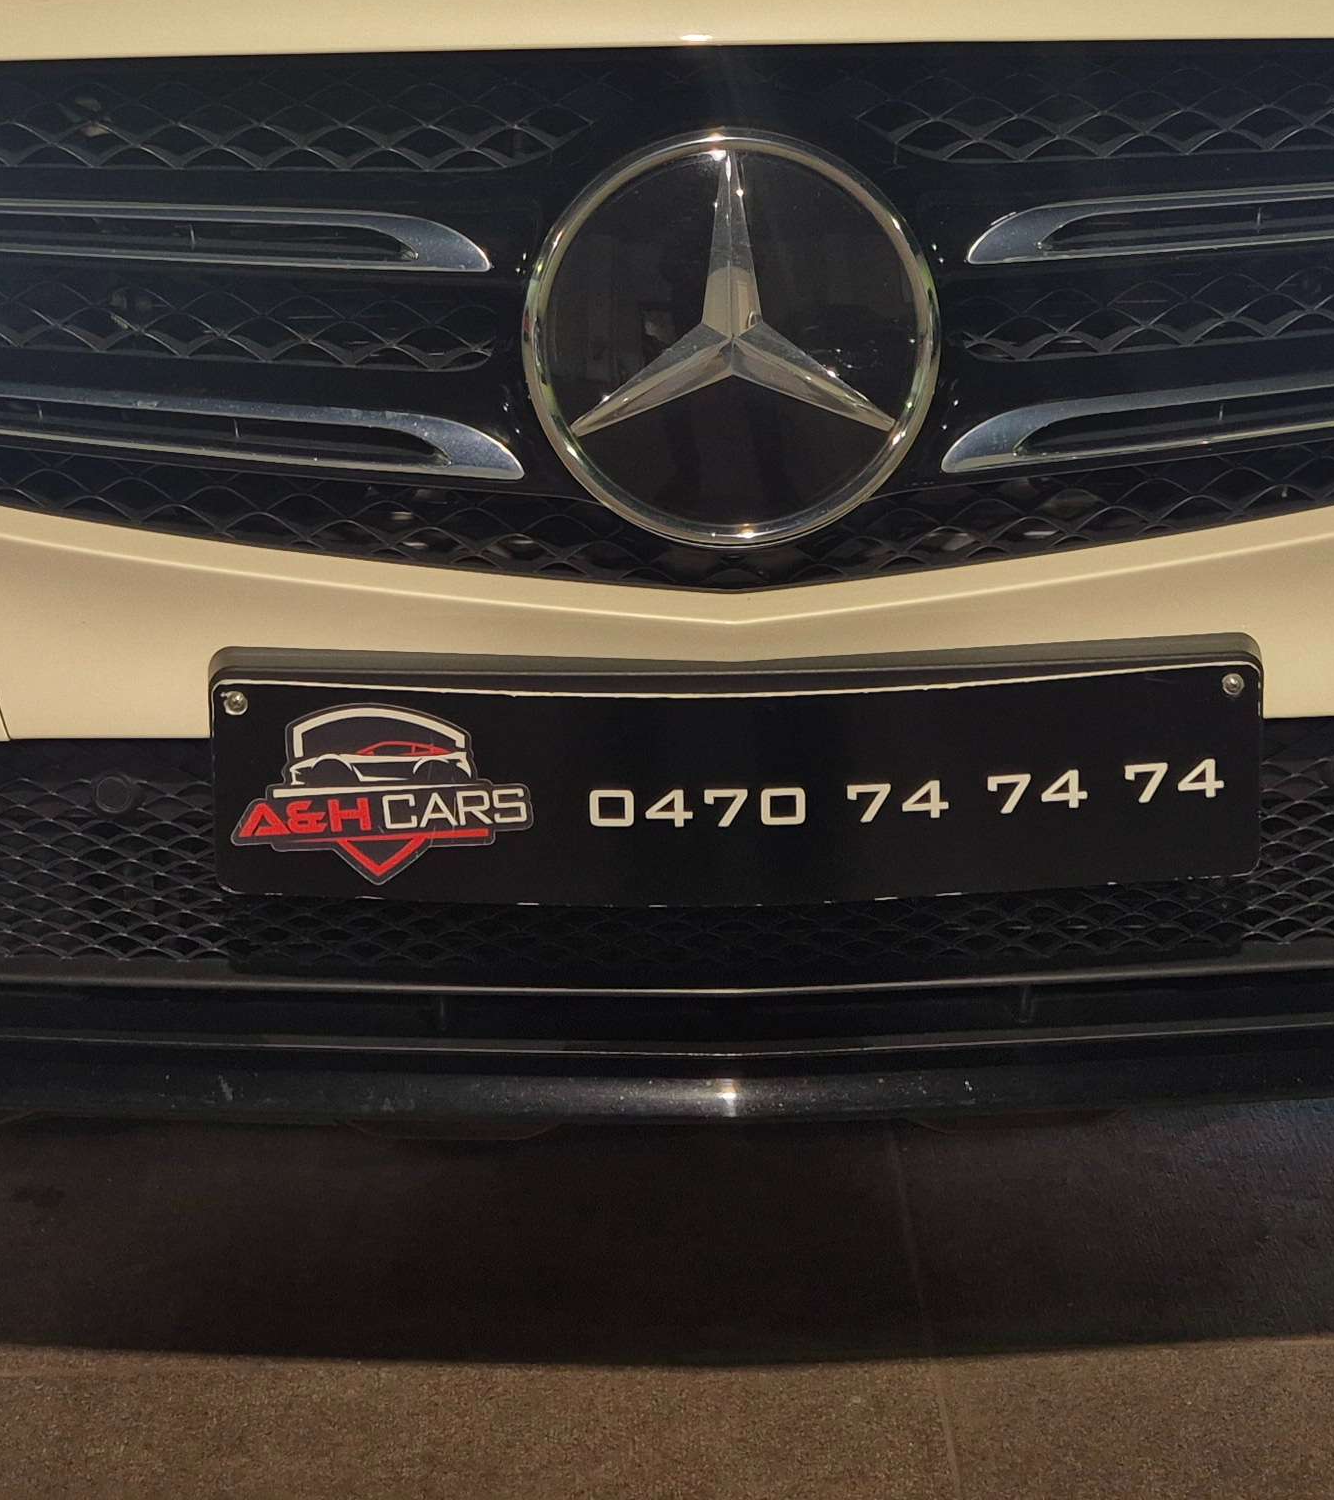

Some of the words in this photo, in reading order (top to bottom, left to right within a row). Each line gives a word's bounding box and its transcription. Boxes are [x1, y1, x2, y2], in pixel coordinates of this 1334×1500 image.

[239, 798, 373, 838] A&H
[382, 788, 528, 829] CARS
[589, 788, 806, 827] 0470
[847, 778, 949, 822] 74
[988, 769, 1088, 813] 74
[1124, 758, 1225, 803] 74
